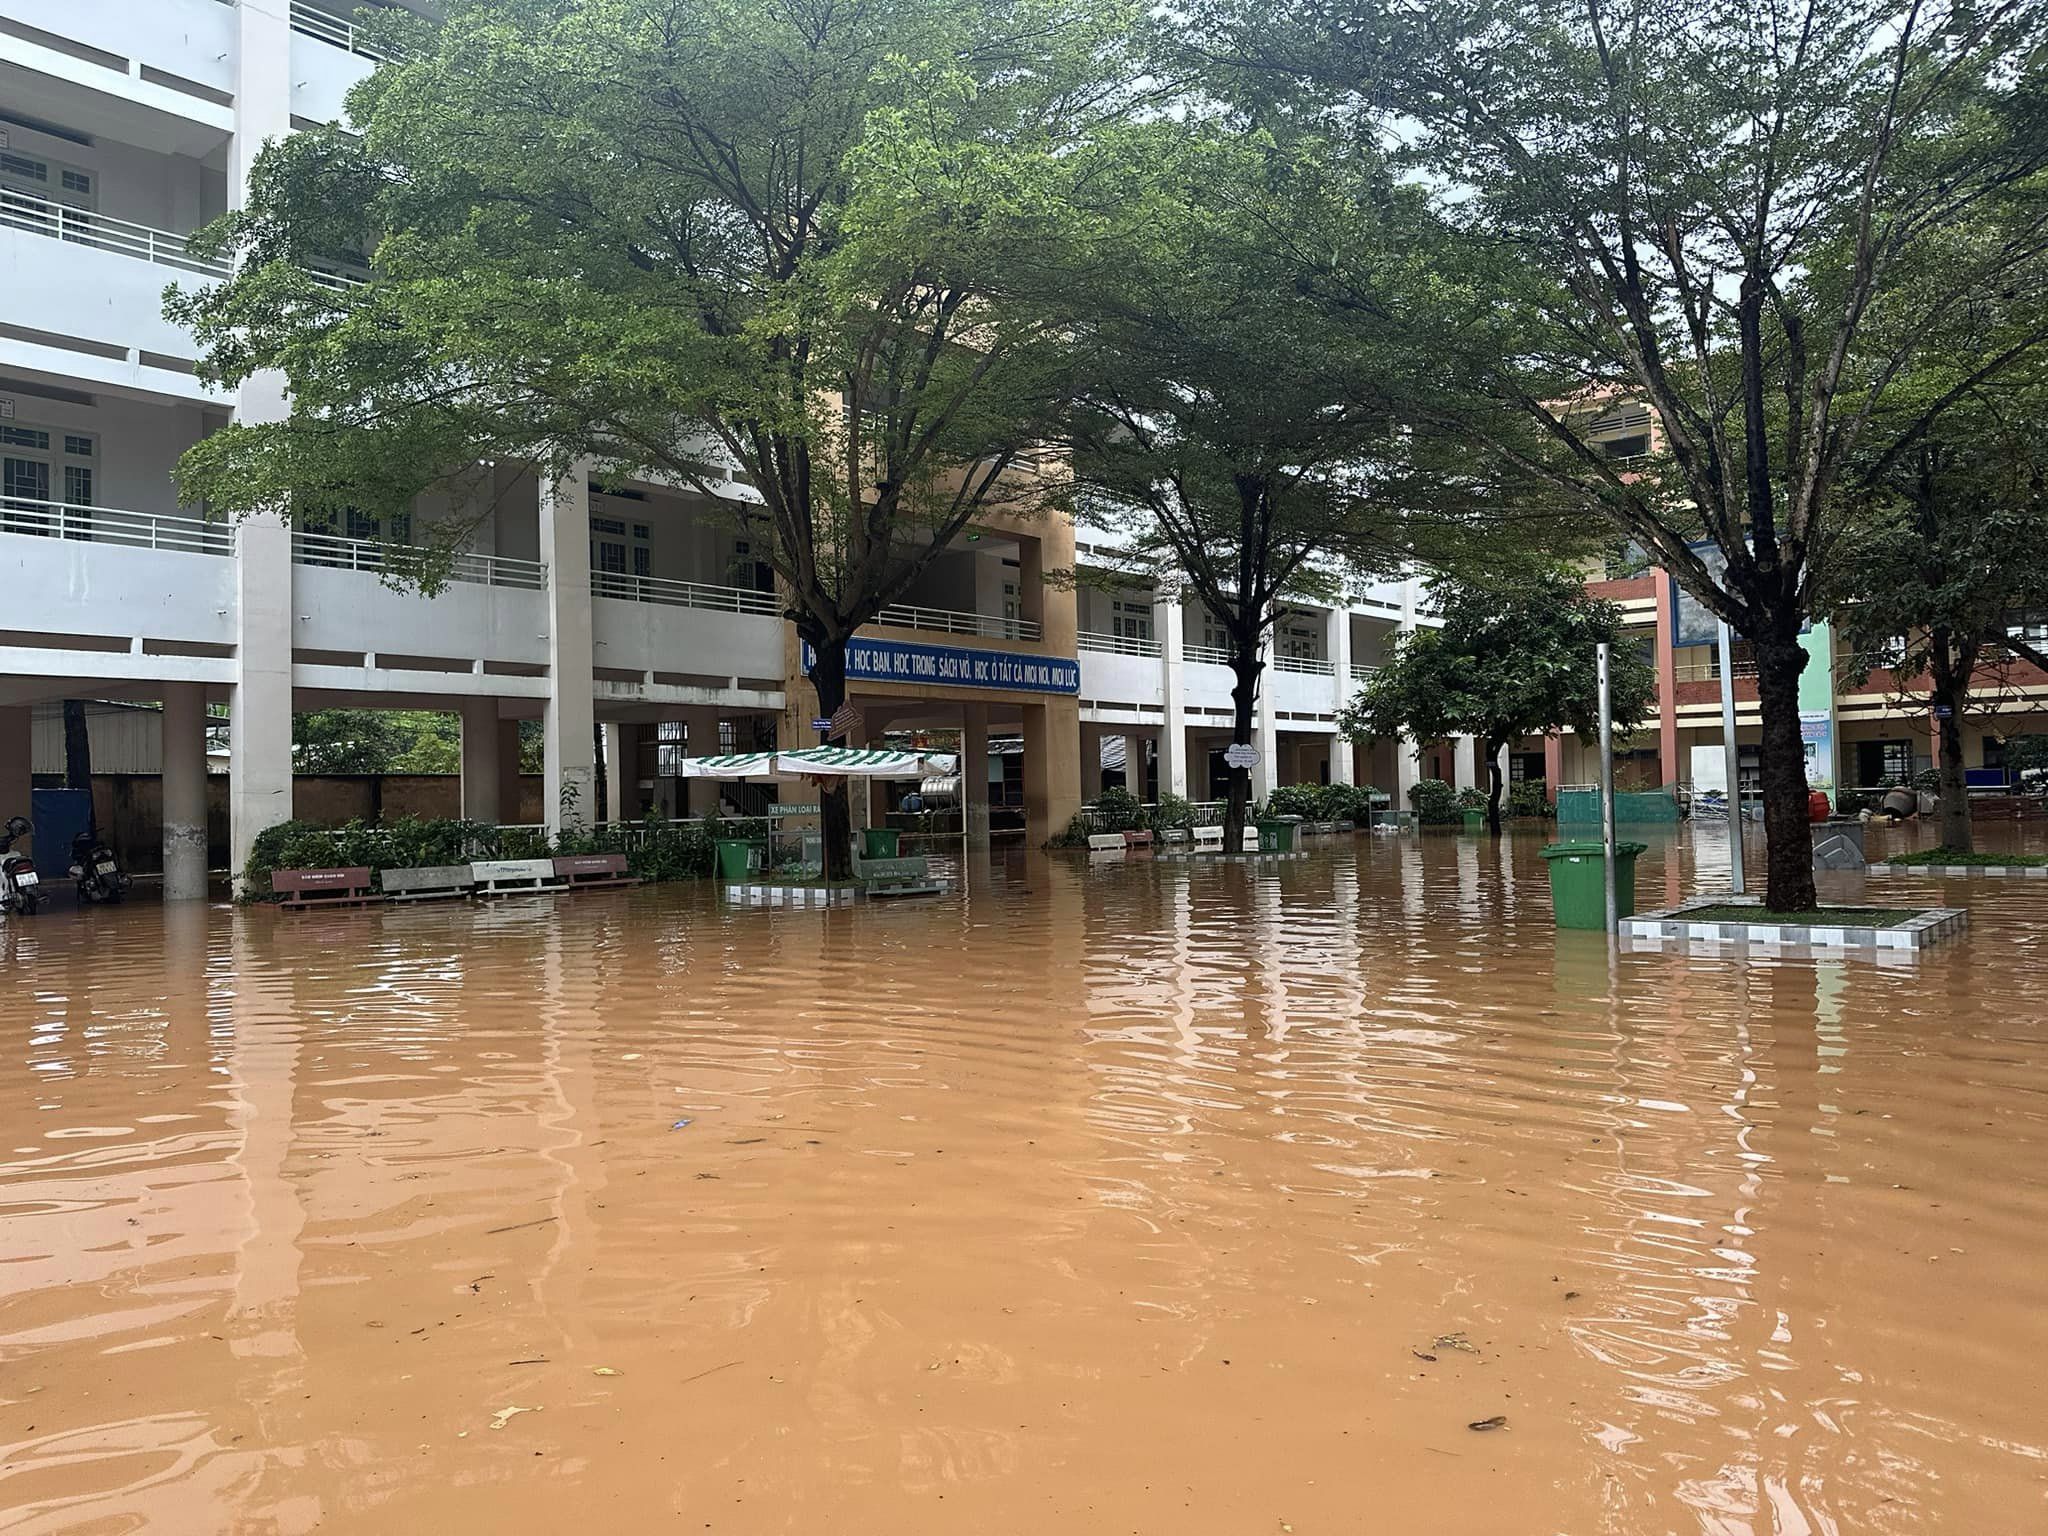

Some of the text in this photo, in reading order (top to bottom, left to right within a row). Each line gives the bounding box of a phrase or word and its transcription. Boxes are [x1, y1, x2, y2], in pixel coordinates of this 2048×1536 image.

[854, 648, 871, 674] HỌC
[894, 652, 909, 676] HỌC
[911, 654, 936, 677] TRONG
[939, 652, 958, 679] SÁCH
[974, 659, 989, 684] HỌC
[999, 655, 1012, 682] TẤT
[1013, 659, 1023, 683] CẢ
[1024, 664, 1037, 686] MỌI
[1051, 667, 1064, 688] MỌI
[1065, 665, 1076, 688] LÚC
[770, 806, 778, 815] XE
